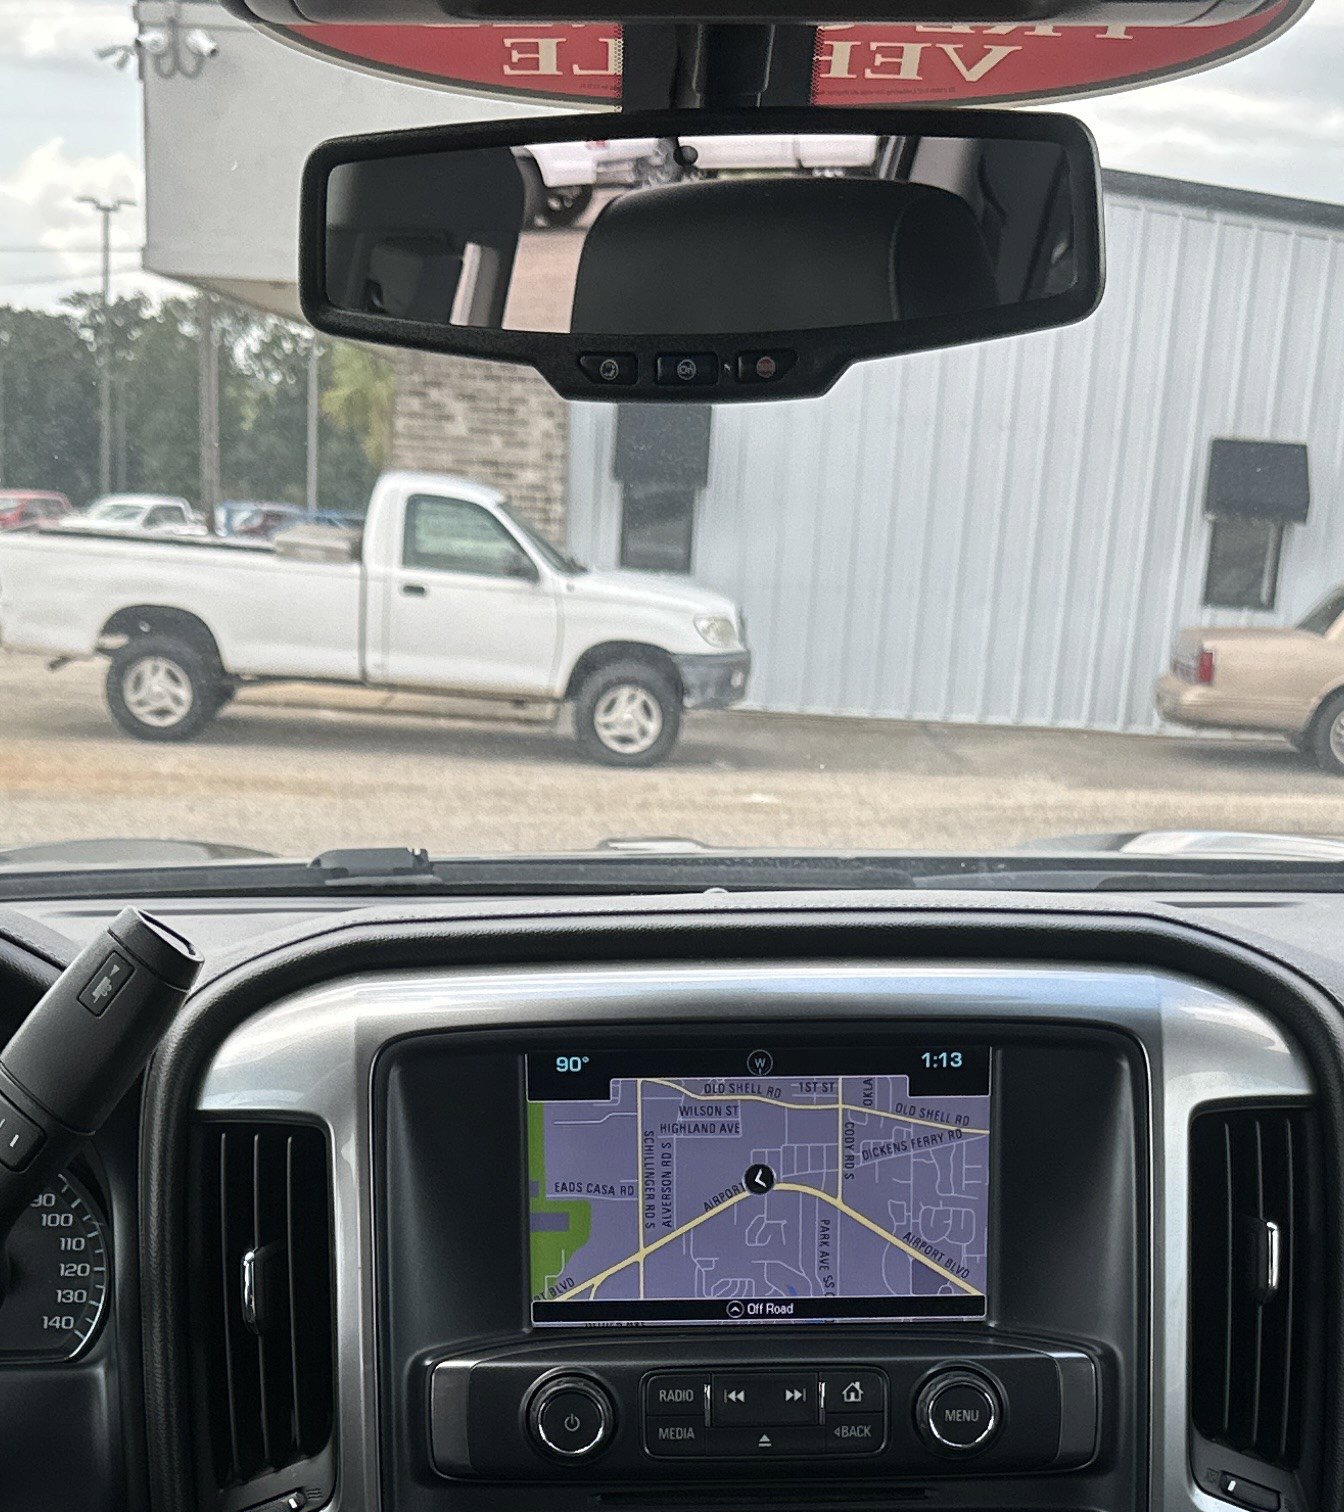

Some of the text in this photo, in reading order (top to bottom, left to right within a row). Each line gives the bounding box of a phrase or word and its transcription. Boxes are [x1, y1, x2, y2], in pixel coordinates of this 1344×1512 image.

[921, 1052, 963, 1068] 1:13
[704, 1082, 782, 1098] OLD SHELL RD
[821, 1082, 835, 1092] ST
[679, 1105, 739, 1117] WILSON ST
[895, 1103, 970, 1127] OLD SHELL RD
[660, 1123, 740, 1134] HIGHLAND AVE
[844, 1121, 855, 1151] CODY
[861, 1129, 963, 1161] DICKENS FERRY RD
[644, 1130, 655, 1201] SCHILLINGER
[661, 1152, 672, 1167] RD
[844, 1154, 855, 1170] RD
[586, 1182, 615, 1195] CASA
[619, 1184, 634, 1196] RD
[661, 1171, 672, 1228] ALVERSON
[703, 1182, 746, 1212] AIRPORT
[645, 1204, 655, 1219] RD
[41, 1213, 73, 1227] 100
[819, 1219, 830, 1248] PARK
[60, 1237, 86, 1251] 110
[819, 1251, 830, 1272] AVE
[902, 1231, 970, 1279] AIRPORT BLVD
[59, 1263, 90, 1277] 120
[549, 1276, 576, 1296] BLVD
[56, 1289, 87, 1303] 130
[747, 1302, 794, 1315] Off Road
[42, 1315, 74, 1329] 140
[659, 1390, 693, 1402] RADIO
[944, 1408, 980, 1423] MENU
[658, 1427, 695, 1440] MEDIA
[841, 1425, 872, 1438] BACK
